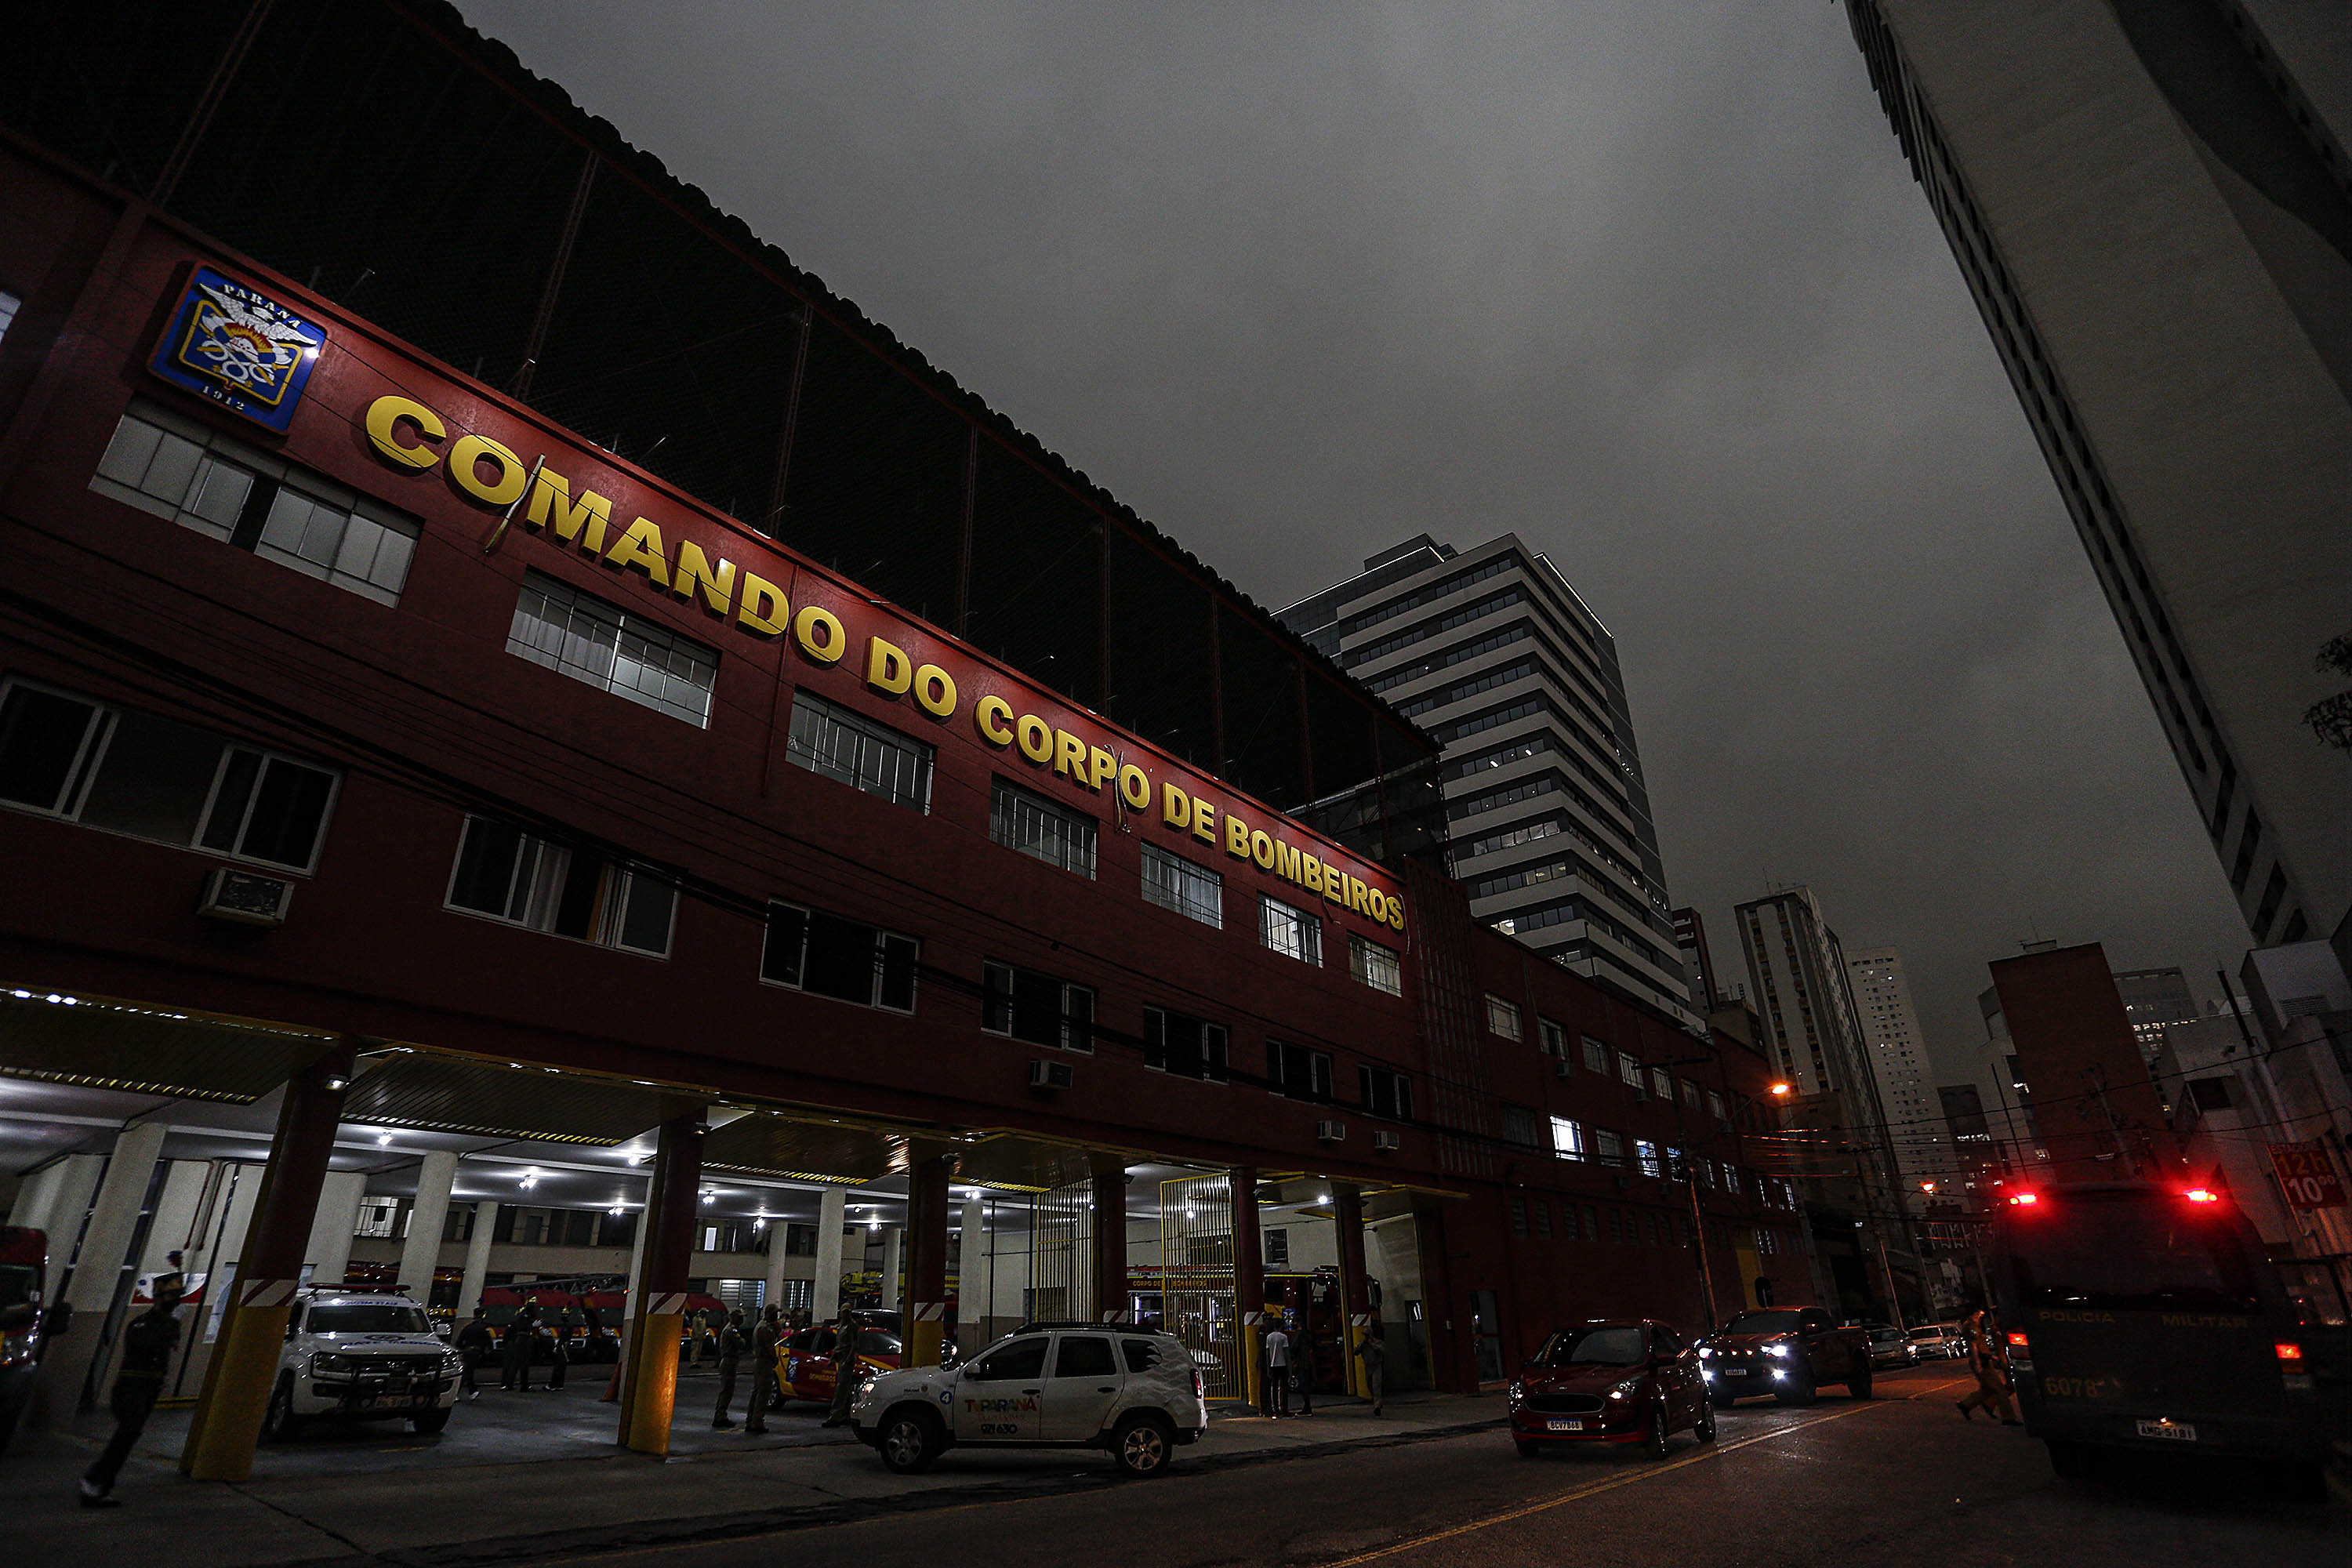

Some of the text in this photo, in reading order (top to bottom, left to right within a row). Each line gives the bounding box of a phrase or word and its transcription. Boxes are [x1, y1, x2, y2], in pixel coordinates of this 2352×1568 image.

[201, 384, 245, 411] 1912
[365, 394, 1405, 933] COMANDO DO CORPO DE BOMBEIROS
[2275, 1152, 2332, 1175] 12h
[941, 1392, 951, 1403] 4
